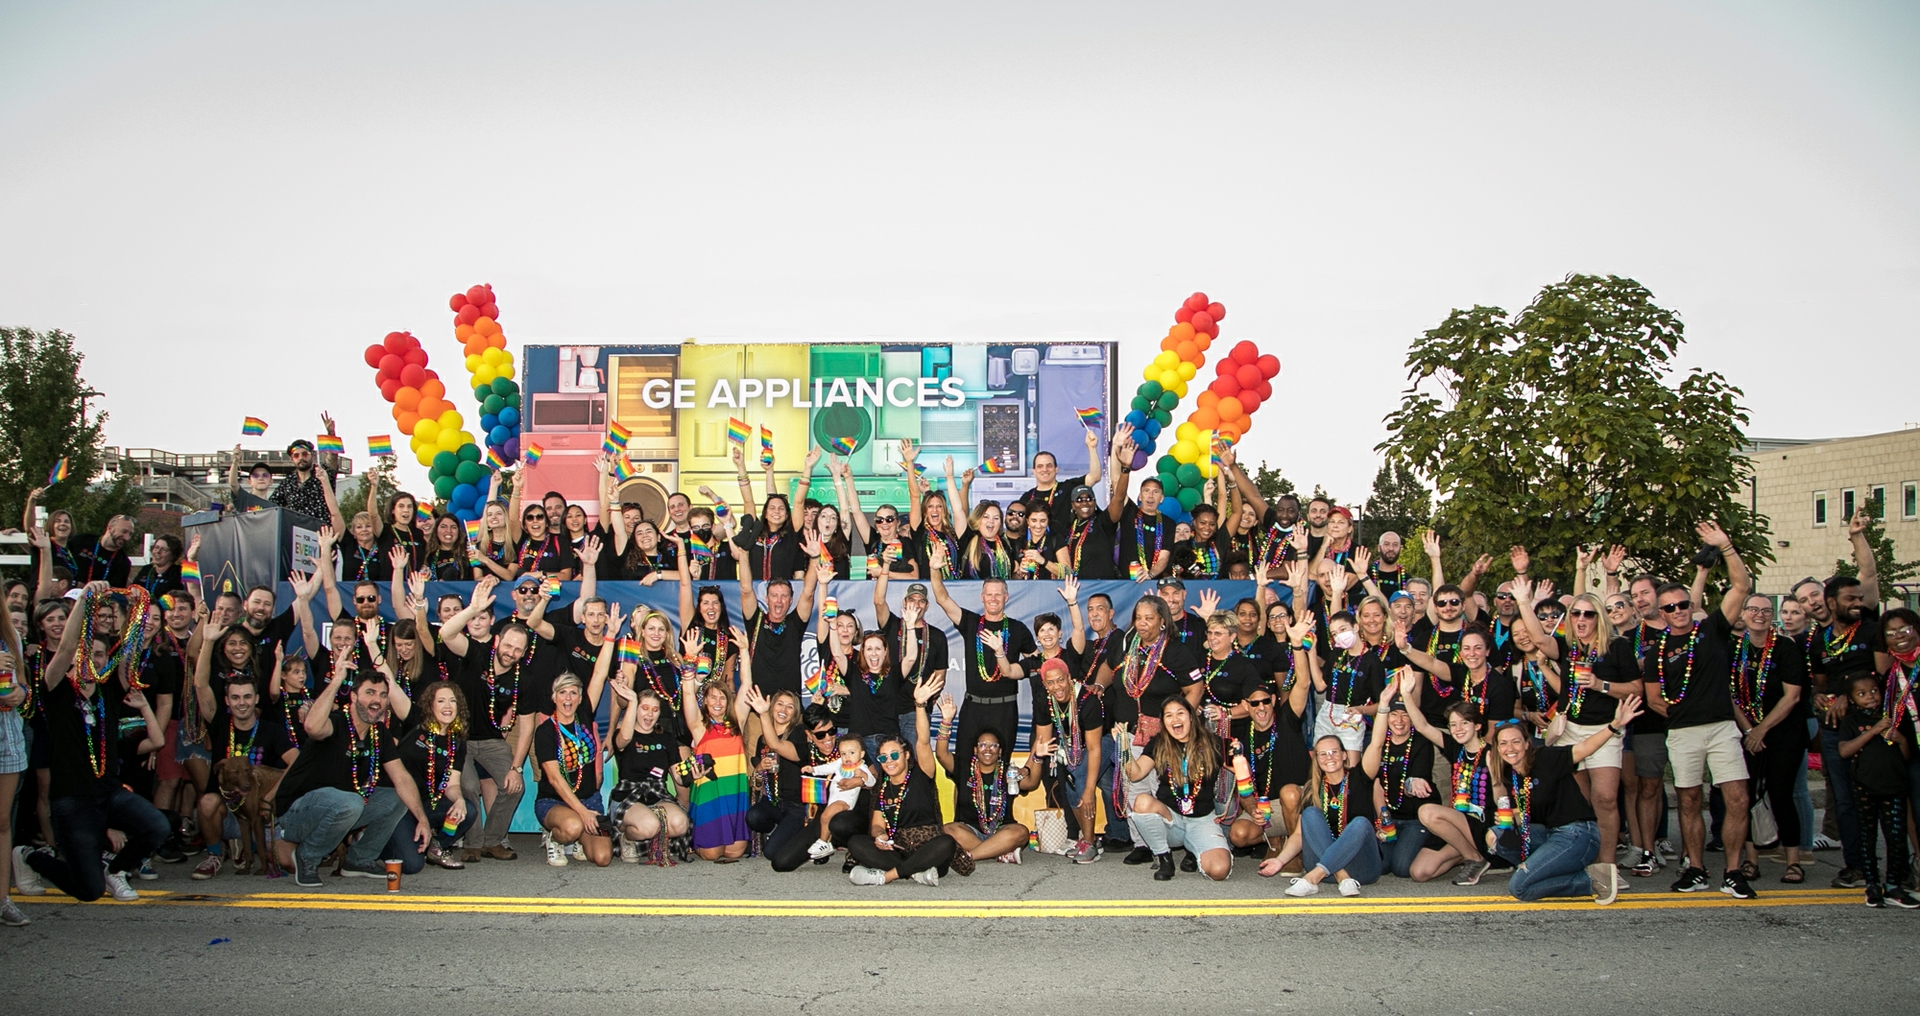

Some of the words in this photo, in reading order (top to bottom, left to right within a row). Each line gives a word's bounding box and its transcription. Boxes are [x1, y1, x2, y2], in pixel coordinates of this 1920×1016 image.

[641, 378, 696, 409] GE
[707, 377, 966, 408] APPLIANCES
[295, 542, 317, 558] EVERY
